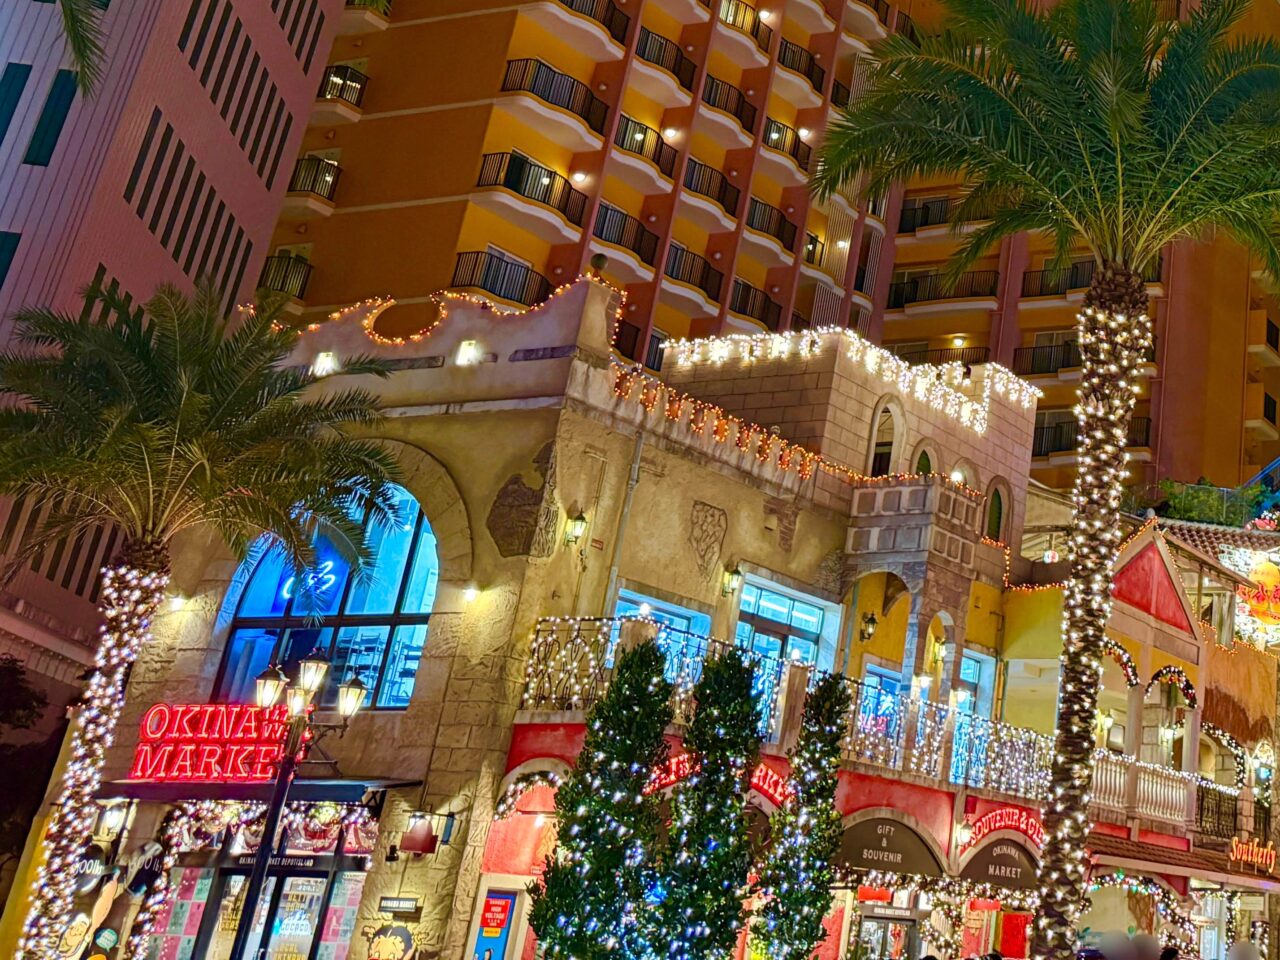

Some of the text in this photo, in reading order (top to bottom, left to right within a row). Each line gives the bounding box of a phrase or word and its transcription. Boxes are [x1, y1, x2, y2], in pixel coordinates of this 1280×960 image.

[132, 742, 306, 780] MARKE
[877, 824, 895, 835] GIFT
[970, 807, 1020, 845] SOUVENIR
[862, 848, 902, 863] SOUVENIR
[992, 844, 1020, 862] OKINAWA
[1230, 836, 1276, 873] Southerly
[988, 864, 1022, 879] MARKET
